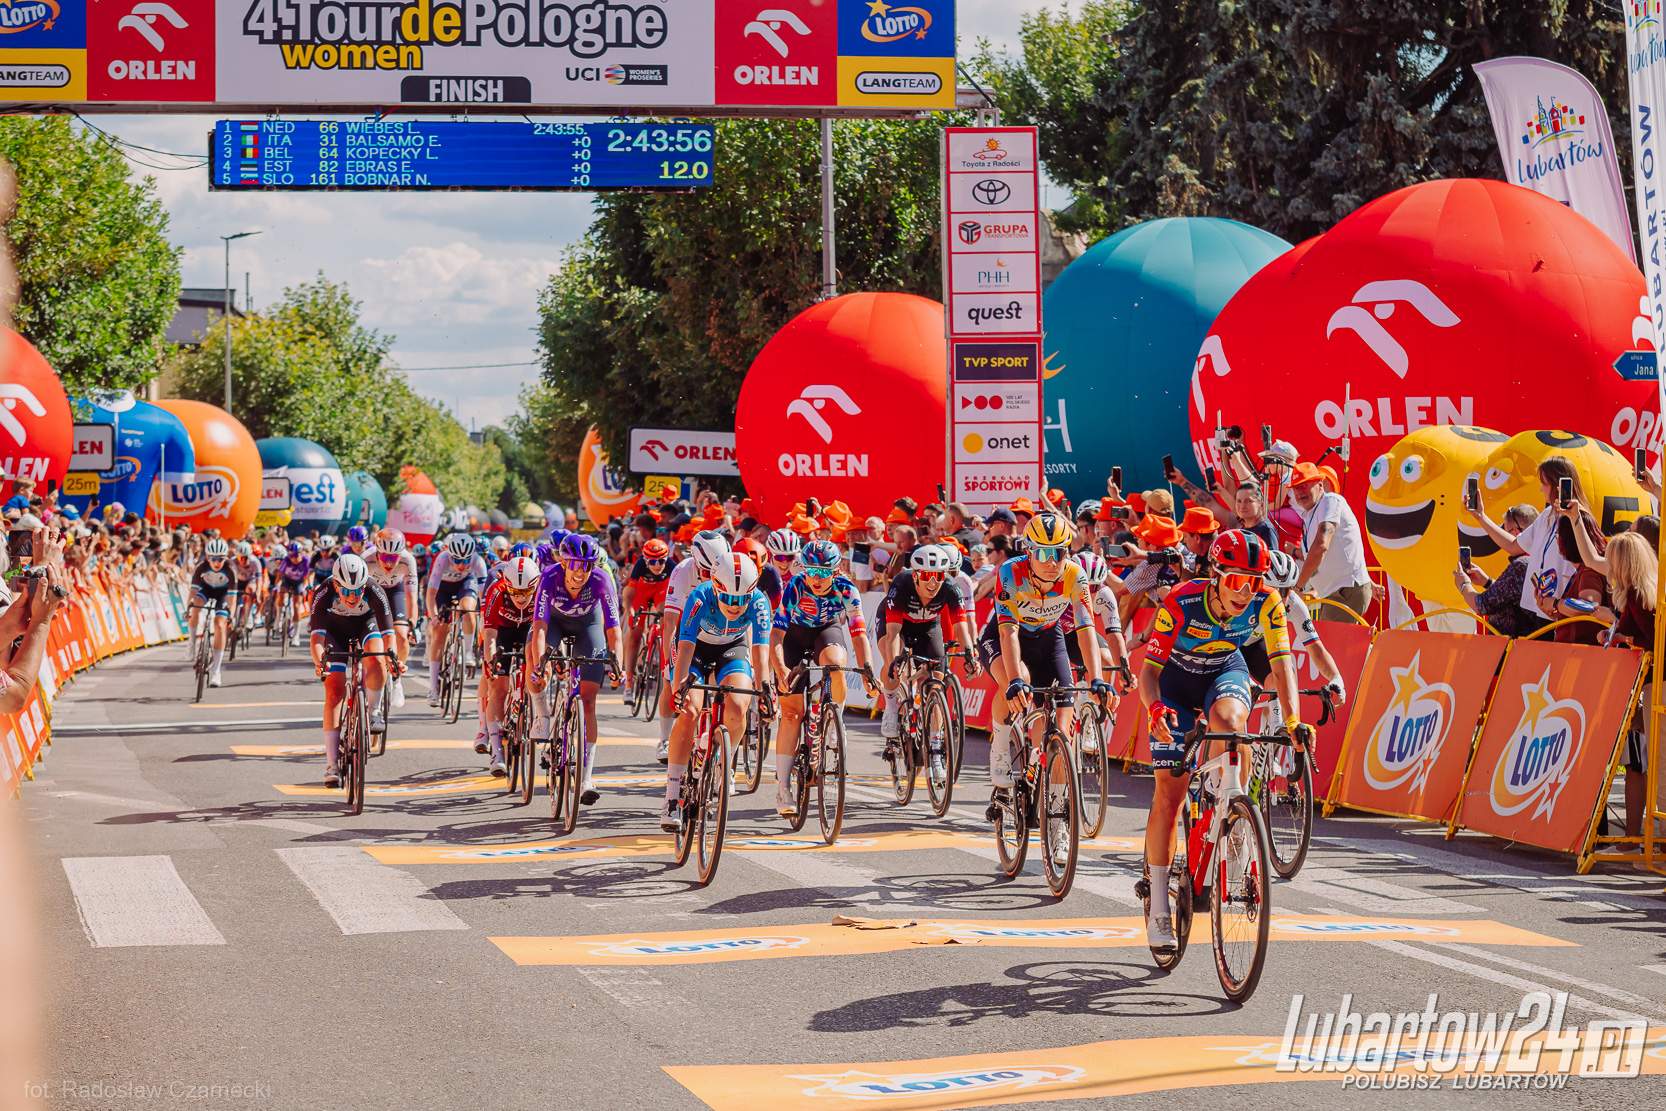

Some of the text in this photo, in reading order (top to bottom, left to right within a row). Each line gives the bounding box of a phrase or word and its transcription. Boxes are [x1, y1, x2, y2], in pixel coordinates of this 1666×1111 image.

[1, 3, 46, 27] LOTTO
[875, 13, 919, 36] LOTTO
[280, 43, 423, 70] women
[0, 71, 65, 81] ANGTEAM
[107, 60, 196, 81] ORLEN
[565, 67, 601, 82] UCI
[734, 65, 819, 85] ORLEN
[428, 79, 504, 102] FINISH
[862, 78, 936, 89] LANGTEAM
[224, 122, 232, 133] 1
[263, 122, 295, 133] NED
[319, 122, 339, 133] 66
[346, 122, 404, 134] WIEBES
[408, 123, 420, 134] L.
[223, 135, 591, 148] 2 ITA 31 BALSAMO E. +0
[607, 128, 712, 152] 2:43:56
[223, 148, 591, 160] 3 BEL 64 KOPECKY L. +0
[222, 160, 591, 174] 4 EST 82 EBRAS E. +0
[659, 160, 709, 179] 12.0
[222, 173, 590, 186] 5 SLO 161 BOBNAR N. +0
[984, 225, 1028, 234] GRUPA
[978, 271, 1010, 284] PHH
[968, 301, 1022, 325] quest
[964, 357, 1029, 368] TVP SPORT
[1634, 364, 1654, 376] Jana
[1315, 396, 1474, 439] ORLEN
[988, 434, 1030, 449] onet
[674, 445, 736, 461] ORLEN
[778, 453, 869, 477] ORLEN
[66, 478, 97, 490] 25m
[171, 478, 223, 503] LOTTO
[964, 481, 1031, 491] SPORTOWY
[1385, 709, 1439, 763] LOTTO
[1510, 727, 1567, 786] LOTTO
[633, 938, 763, 954] LOTTO
[861, 1070, 1025, 1093] LOTTO
